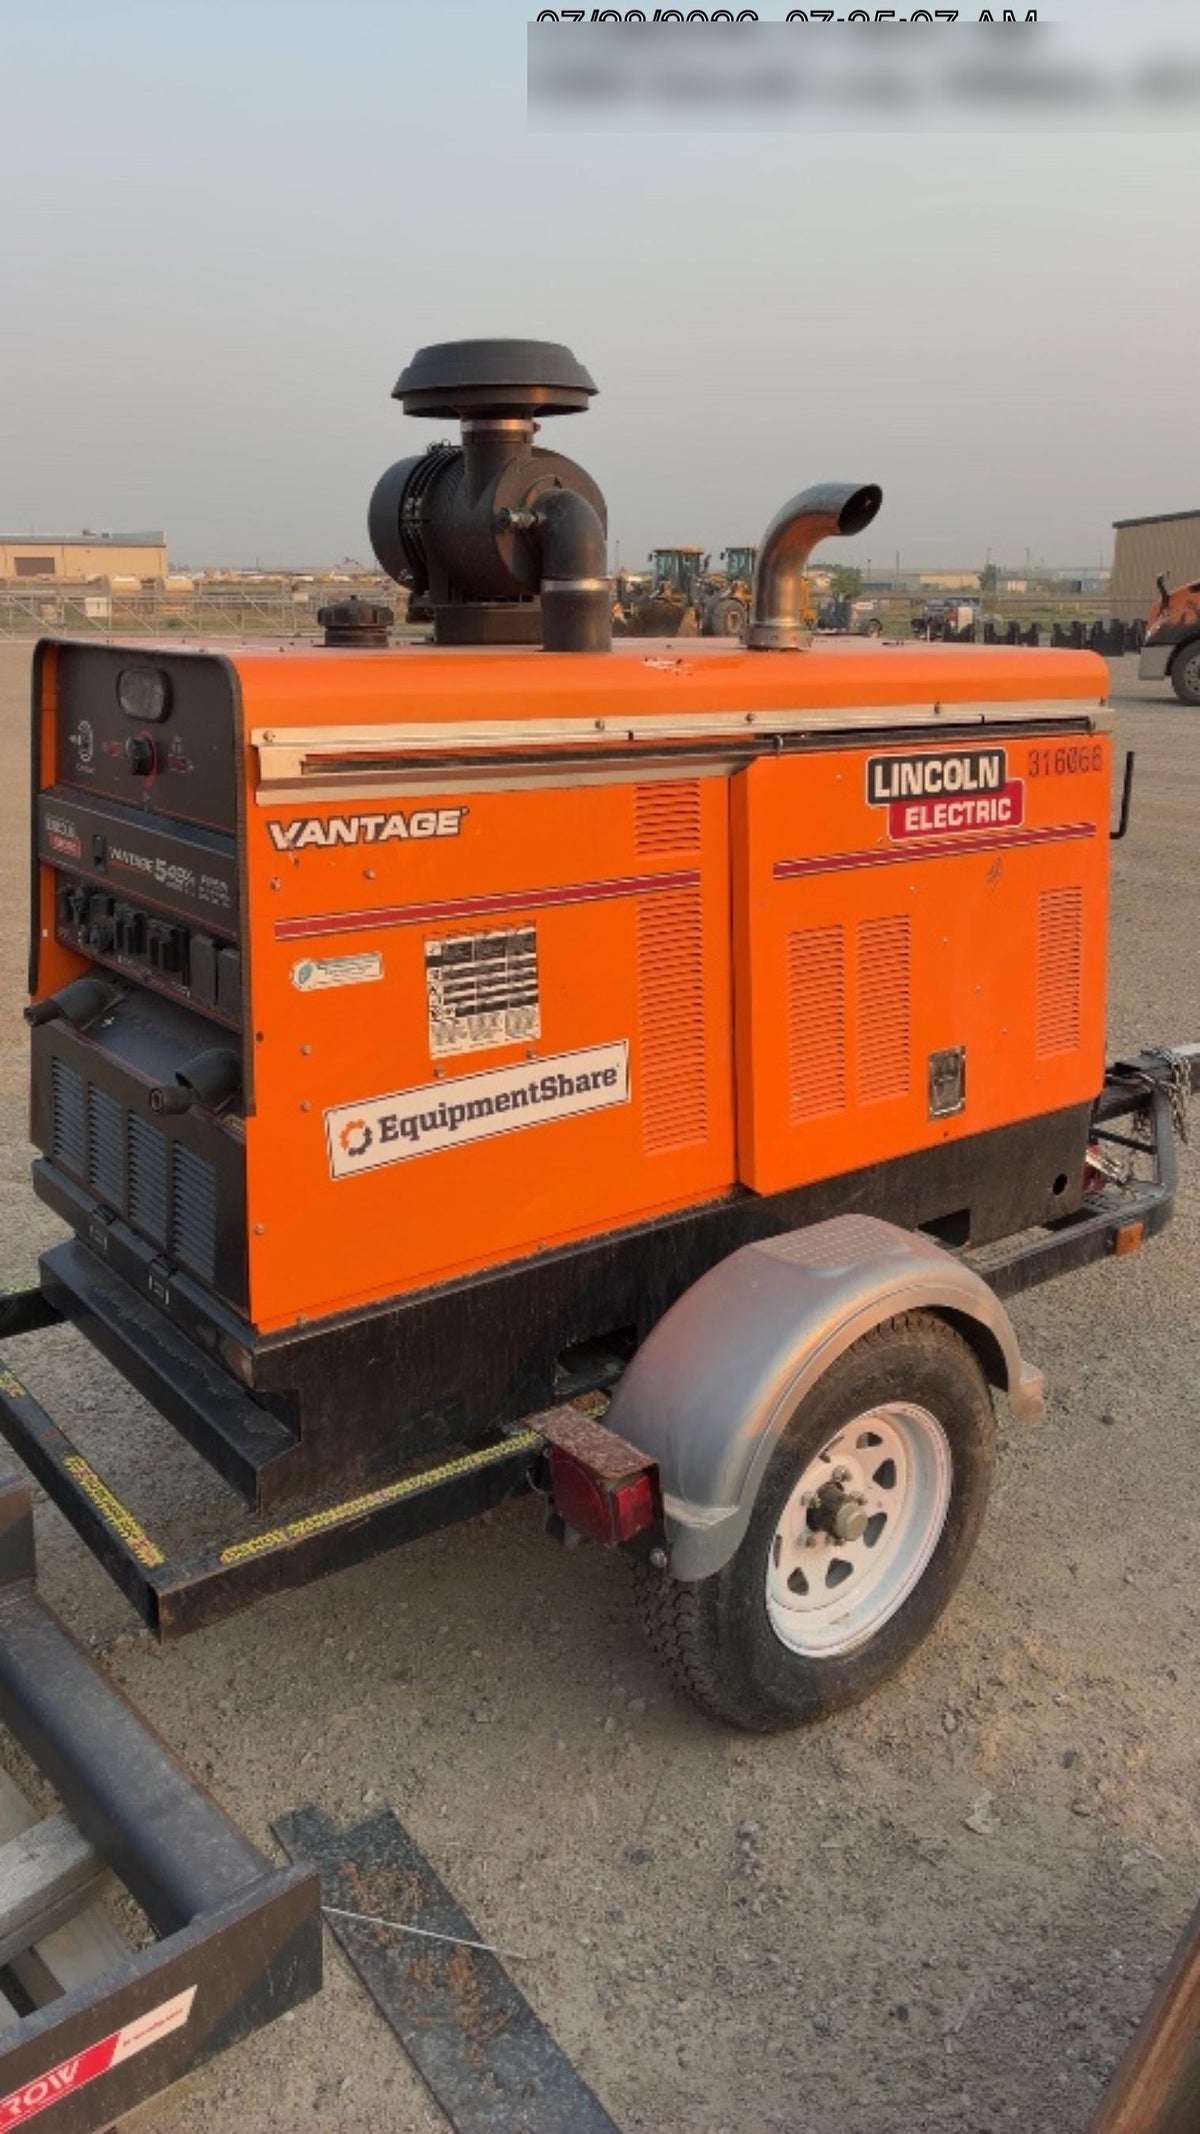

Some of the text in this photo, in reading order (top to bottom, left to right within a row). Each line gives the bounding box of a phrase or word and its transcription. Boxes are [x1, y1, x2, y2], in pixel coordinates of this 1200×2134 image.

[874, 756, 999, 798] LINCOLN
[268, 808, 463, 850] VANTAGE
[905, 798, 1012, 831] ELECTRIC
[379, 1065, 618, 1143] EquipmentShare
